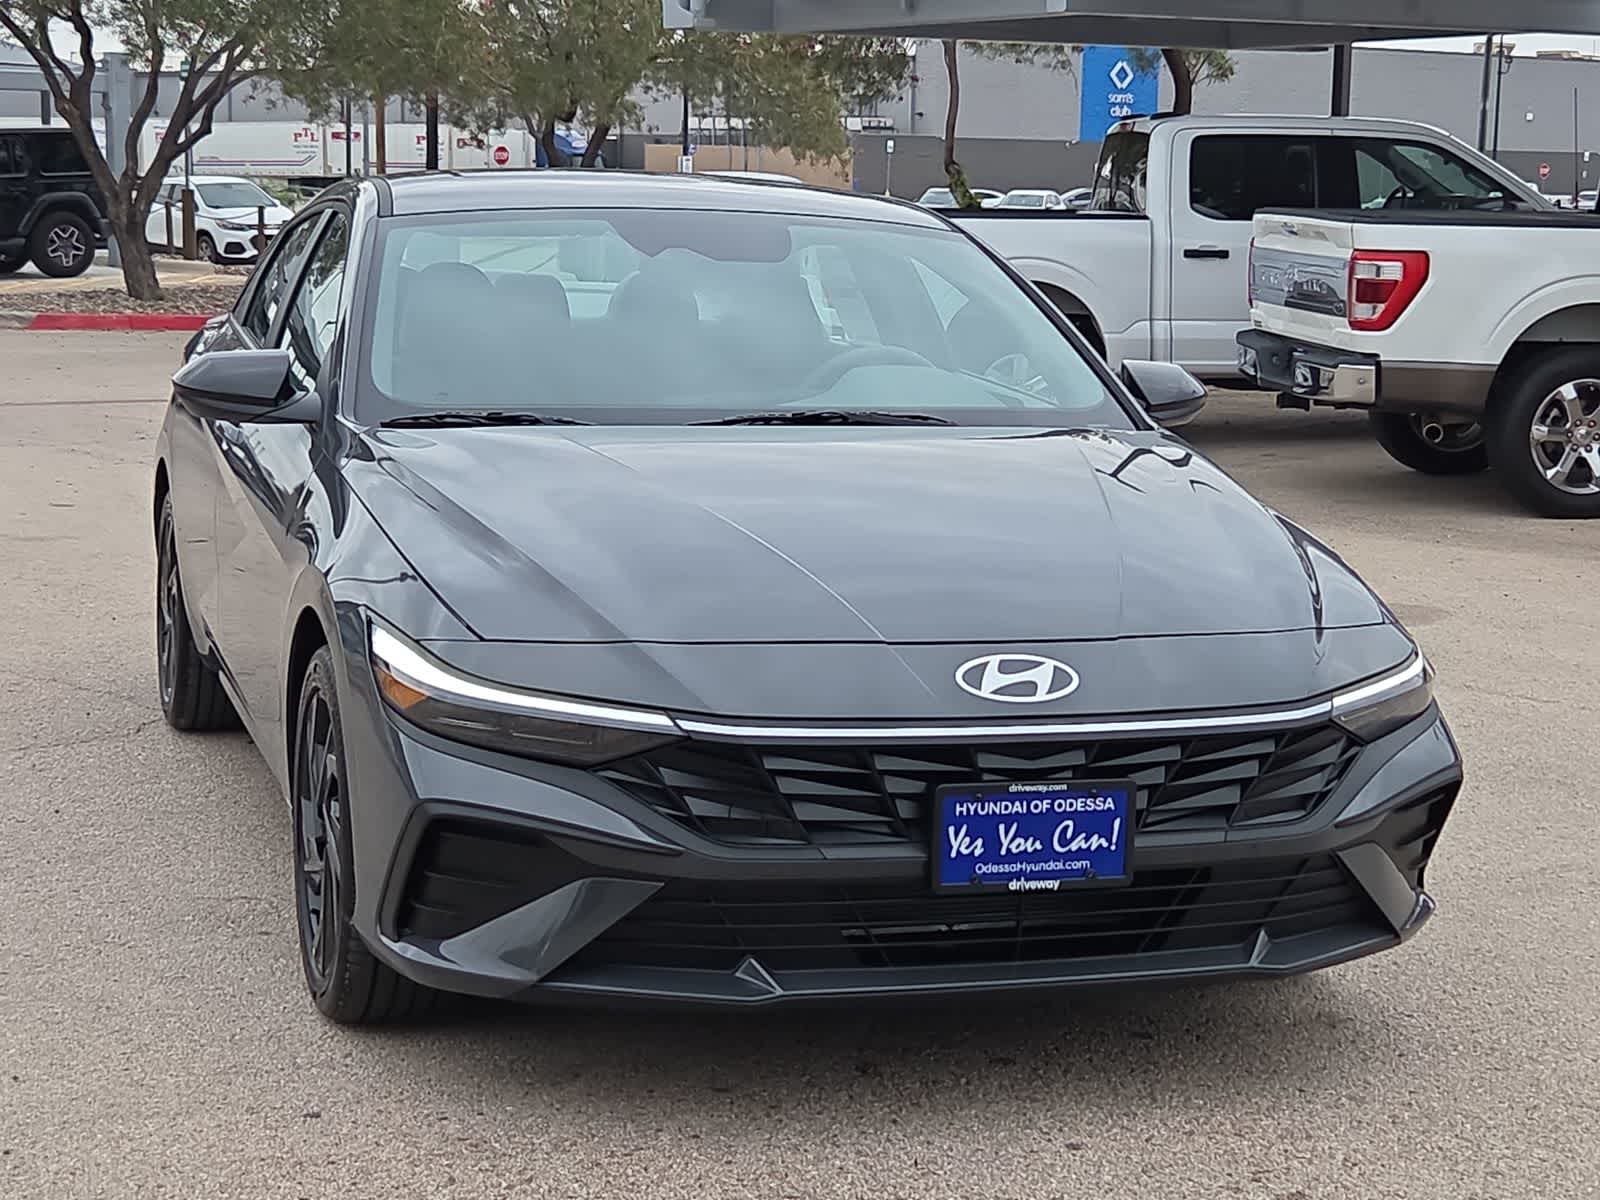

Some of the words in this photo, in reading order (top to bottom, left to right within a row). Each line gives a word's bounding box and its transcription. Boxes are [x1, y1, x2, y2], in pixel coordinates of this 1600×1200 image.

[1110, 105, 1131, 117] club
[1008, 784, 1068, 793] driveway.com
[955, 801, 1027, 816] HYUNDAI
[1030, 800, 1051, 814] OF
[1054, 797, 1115, 813] ODESSA
[948, 824, 984, 858] Yes
[998, 822, 1043, 856] You
[1053, 817, 1121, 853] Can!
[975, 860, 1090, 875] OdessaHyundai.com
[1008, 877, 1060, 892] driveway
